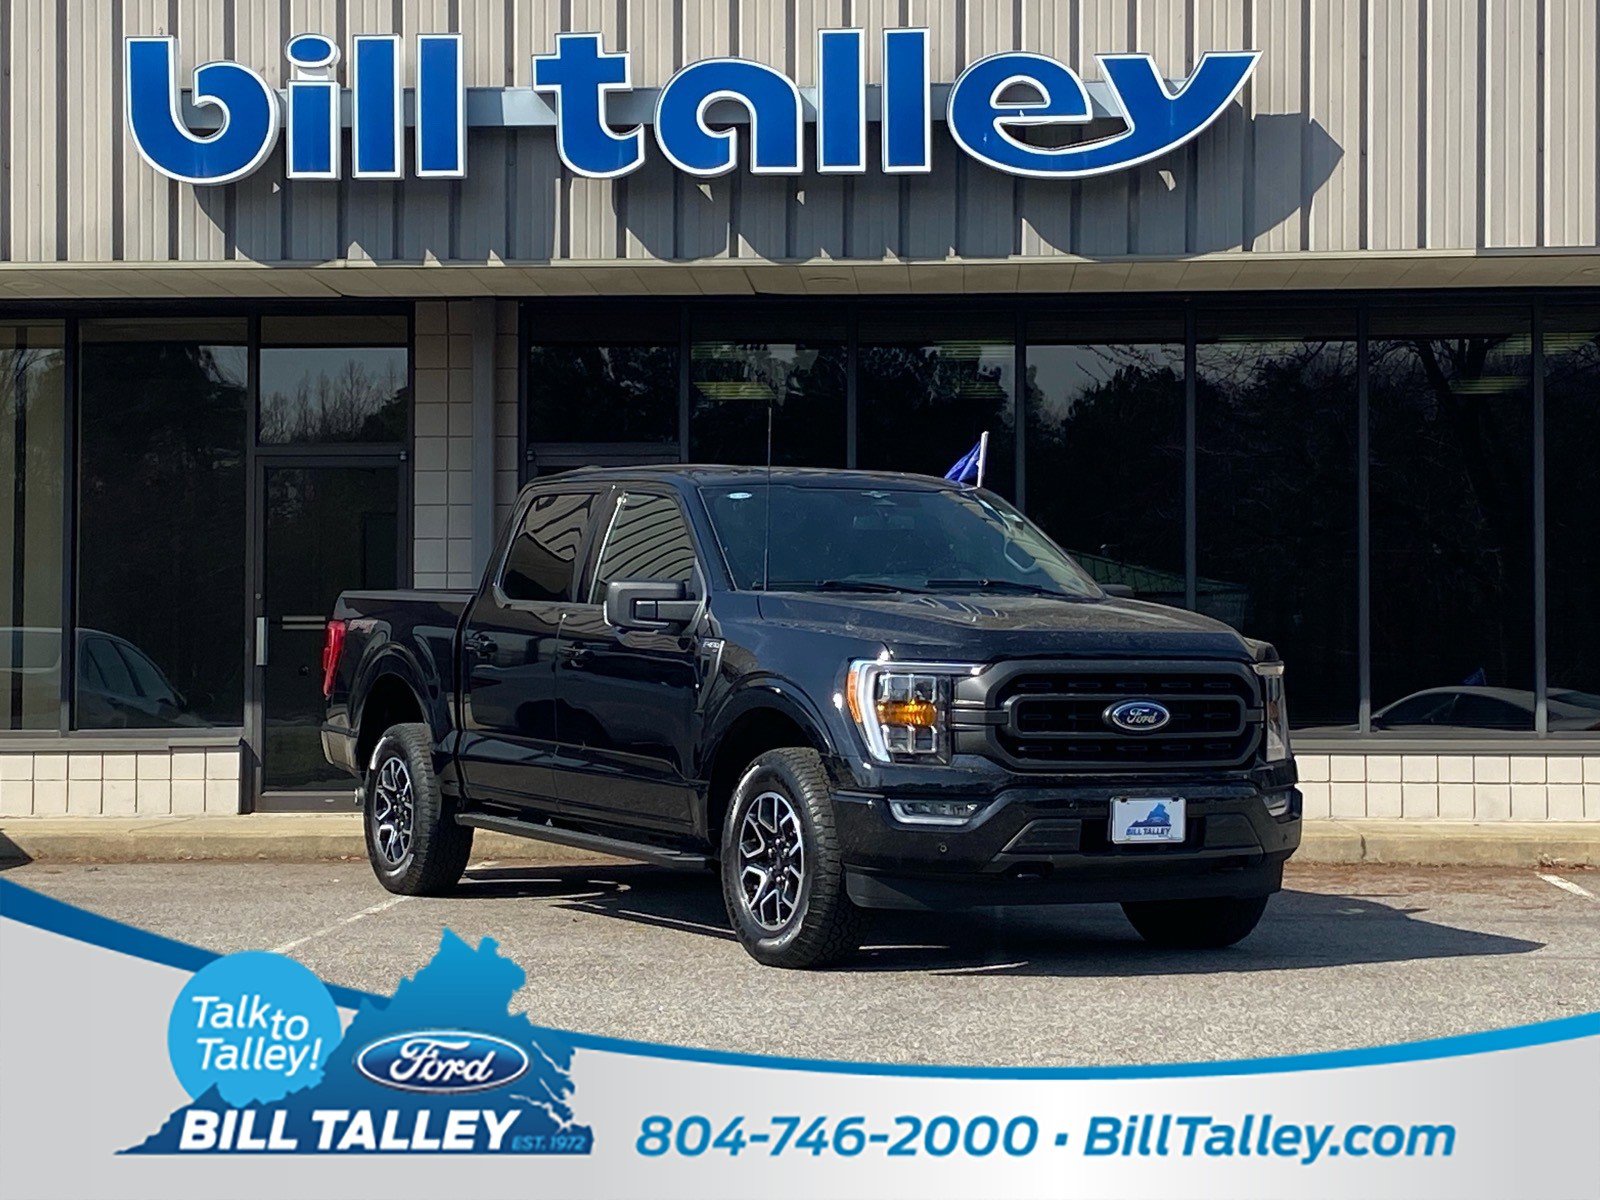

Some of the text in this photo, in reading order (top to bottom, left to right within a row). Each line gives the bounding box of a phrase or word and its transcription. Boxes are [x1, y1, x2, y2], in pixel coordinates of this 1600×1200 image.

[124, 26, 1263, 185] bill talley
[1126, 707, 1158, 724] Ford
[1126, 826, 1171, 835] BILL TALLEY
